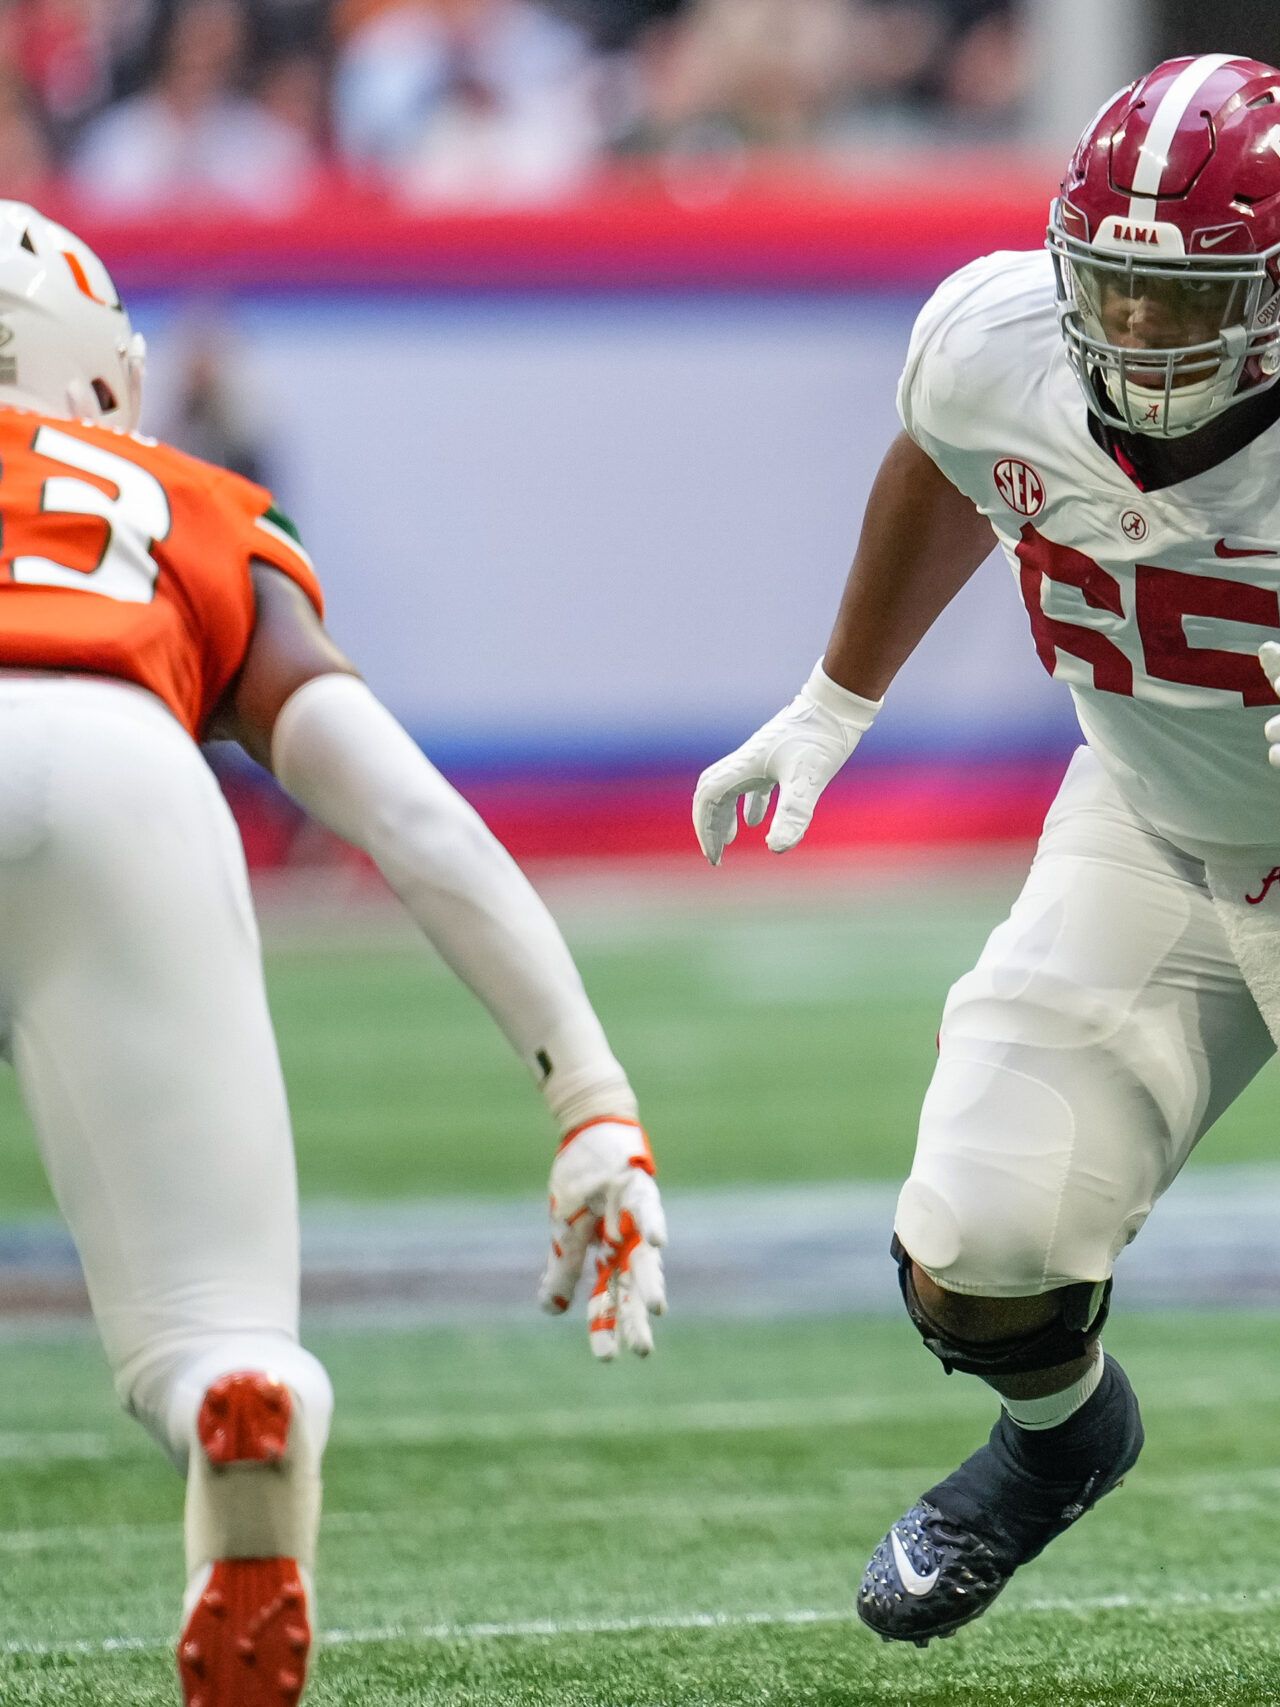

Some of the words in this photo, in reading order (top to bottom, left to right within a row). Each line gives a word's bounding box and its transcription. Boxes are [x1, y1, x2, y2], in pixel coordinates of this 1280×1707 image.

[1112, 223, 1159, 244] BAMA
[0, 425, 172, 605] 3
[996, 460, 1041, 515] SEC
